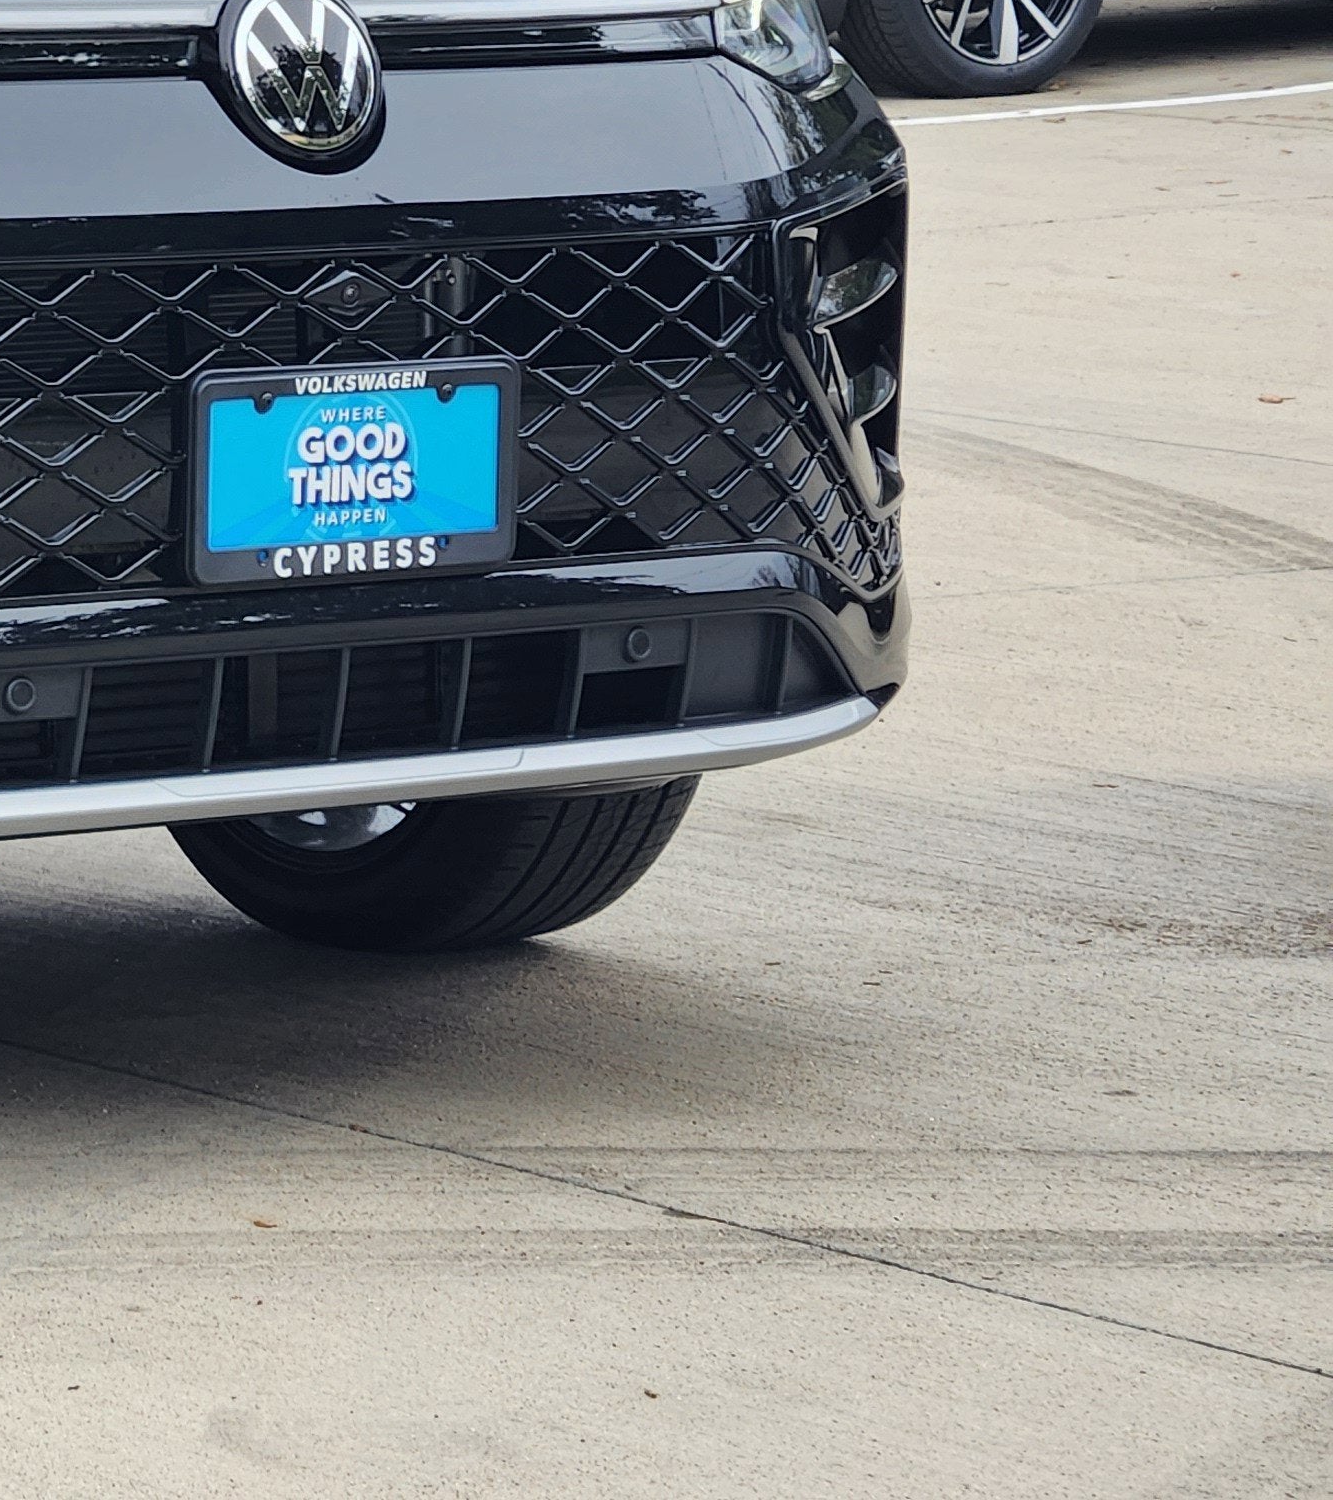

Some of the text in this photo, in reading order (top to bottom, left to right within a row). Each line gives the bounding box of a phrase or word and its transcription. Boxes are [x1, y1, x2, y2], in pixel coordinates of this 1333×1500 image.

[295, 370, 428, 395] VOLKSWAGEN
[320, 406, 387, 424] WHERE
[296, 422, 407, 465] GOOD
[287, 460, 415, 506] THINGS
[313, 508, 388, 527] HAPPEN
[273, 536, 438, 579] CYPRESS
